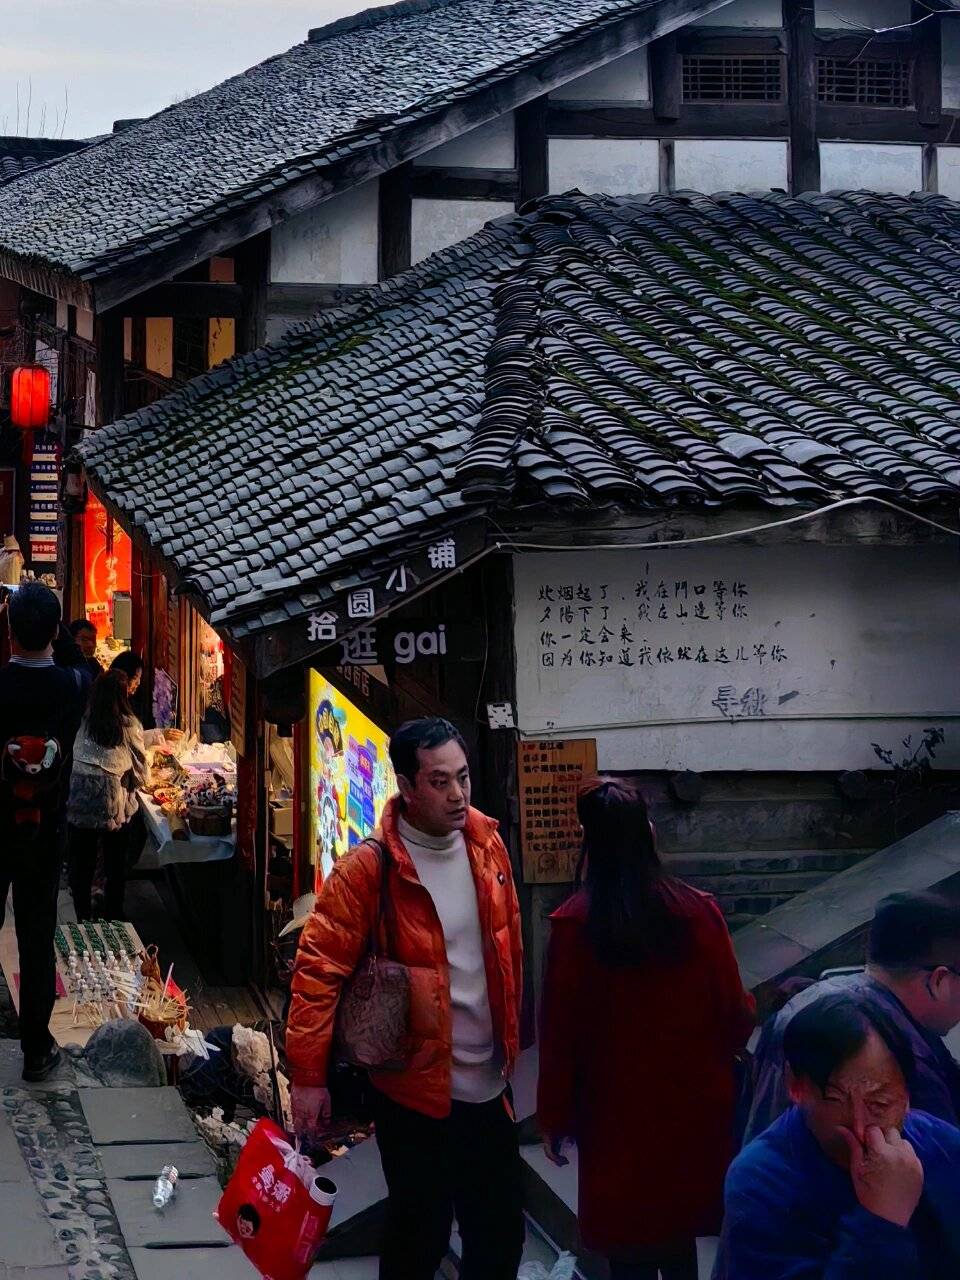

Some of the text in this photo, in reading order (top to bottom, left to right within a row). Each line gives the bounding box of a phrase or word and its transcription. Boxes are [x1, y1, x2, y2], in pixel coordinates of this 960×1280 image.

[307, 538, 457, 641] 拾圆小铺
[339, 624, 448, 665] 逛 gai
